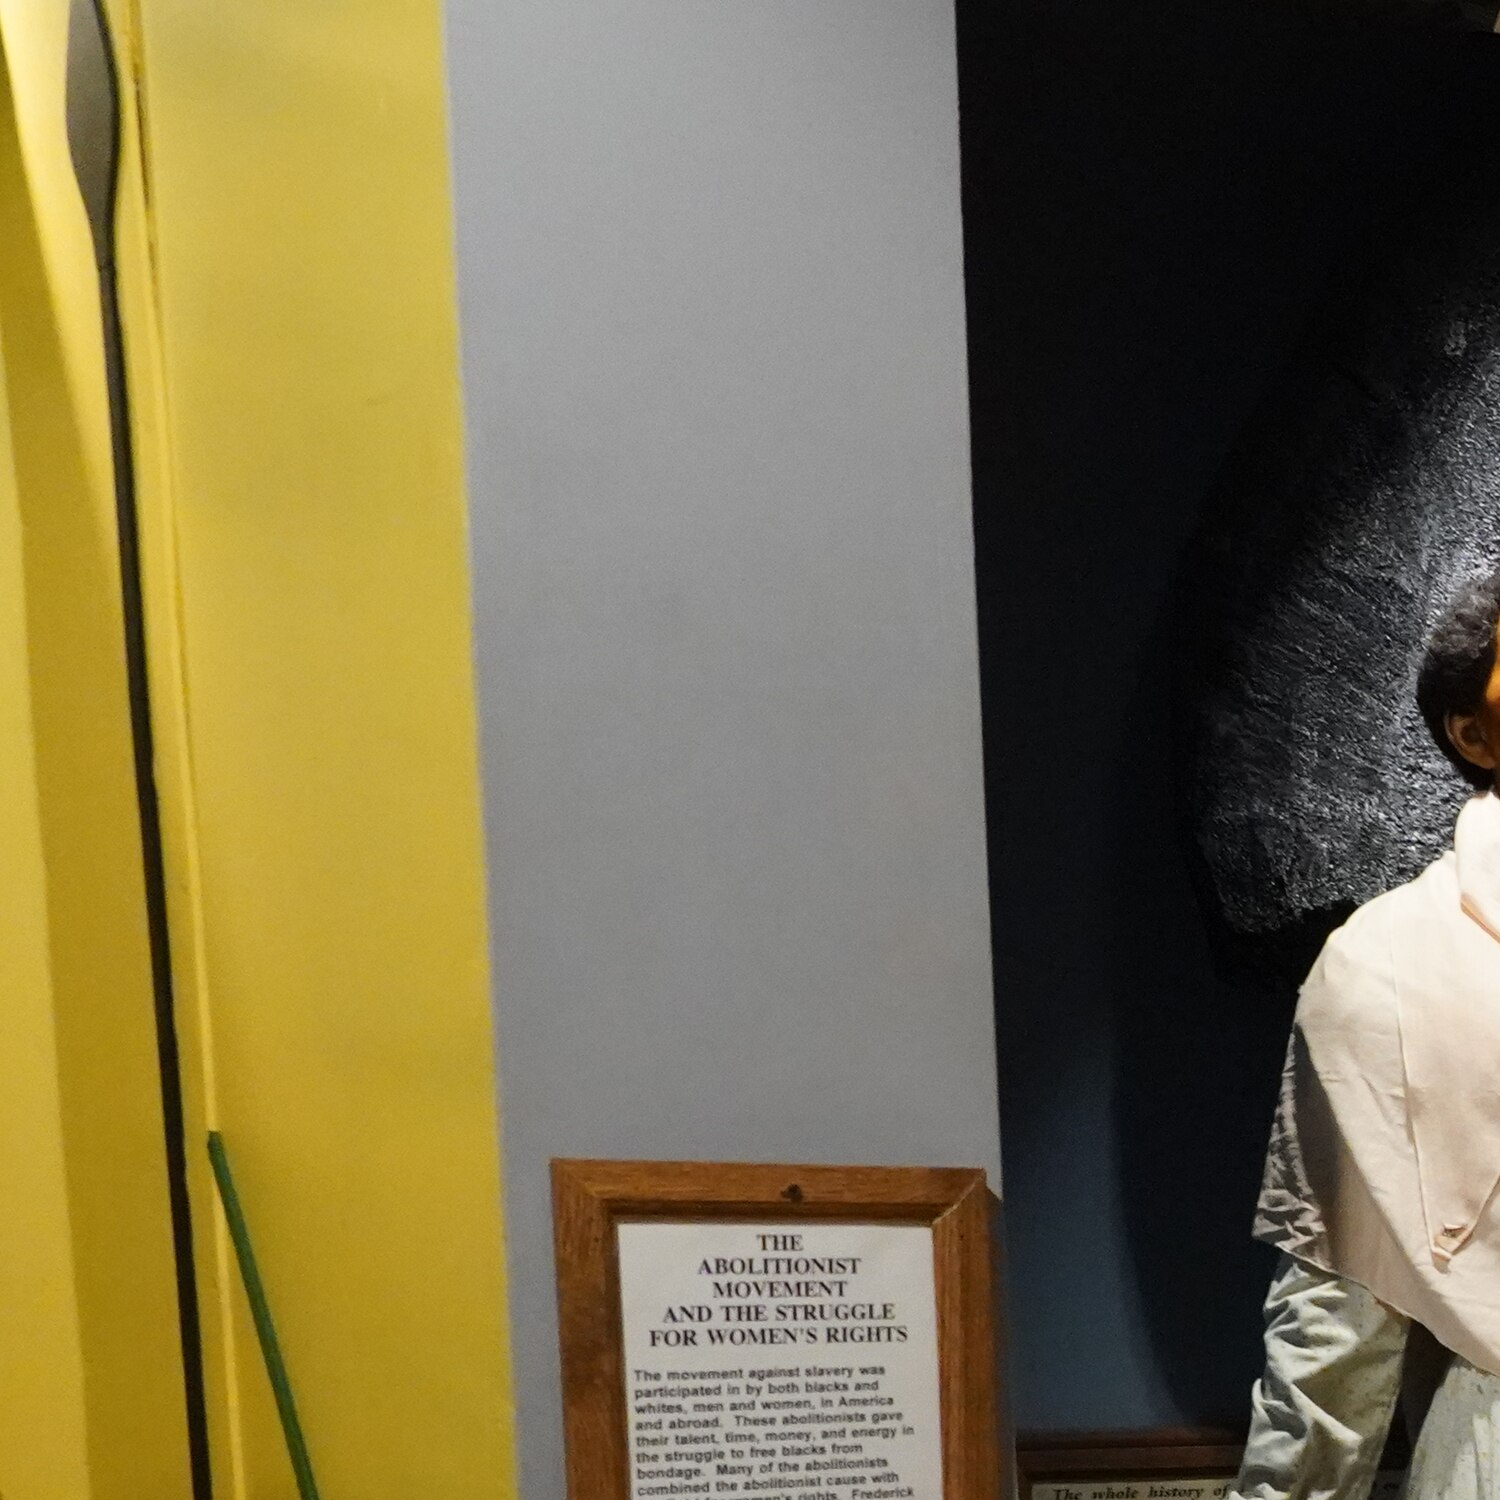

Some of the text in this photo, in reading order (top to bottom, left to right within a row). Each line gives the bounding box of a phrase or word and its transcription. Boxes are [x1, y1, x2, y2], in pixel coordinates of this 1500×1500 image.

[755, 1233, 804, 1252] THE
[698, 1257, 862, 1276] ABOLITIONIST
[712, 1279, 849, 1299] MOVEMENT
[662, 1303, 896, 1324] AND THE STRUGGLE
[649, 1325, 909, 1348] FOR WOMEN'S RIGHTS
[633, 1365, 886, 1382] The movement against slavery was
[633, 1379, 880, 1402] participated in by both blacks and
[692, 1402, 725, 1413] men
[728, 1399, 757, 1412] and
[820, 1396, 834, 1409] in
[837, 1395, 895, 1408] America
